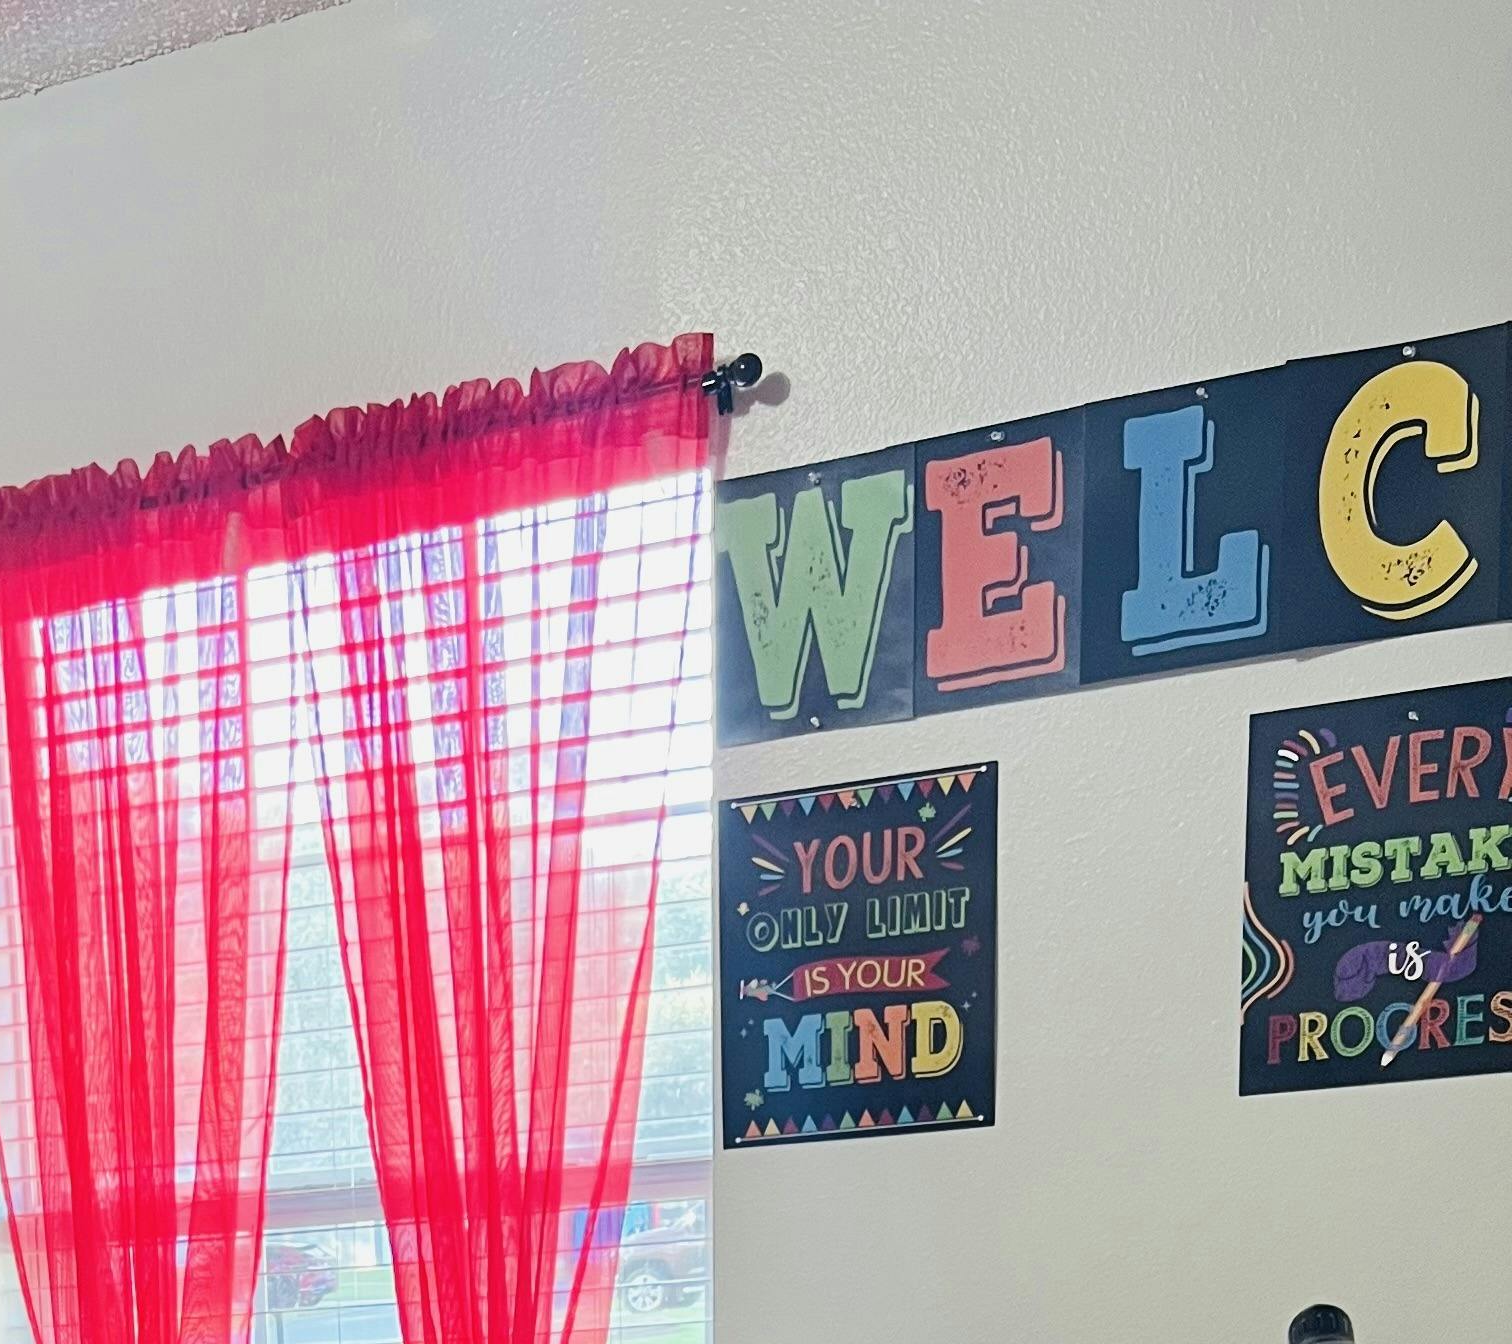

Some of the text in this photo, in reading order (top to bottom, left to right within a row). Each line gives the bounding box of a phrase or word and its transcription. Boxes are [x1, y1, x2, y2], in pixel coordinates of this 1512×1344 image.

[719, 360, 1481, 719] WELC
[793, 826, 927, 894] YOUR
[746, 887, 971, 952] ONLY LIMIT
[1302, 899, 1381, 944] you
[804, 959, 927, 998] IS YOUR
[1388, 938, 1432, 981] is
[763, 1000, 965, 1093] MIND
